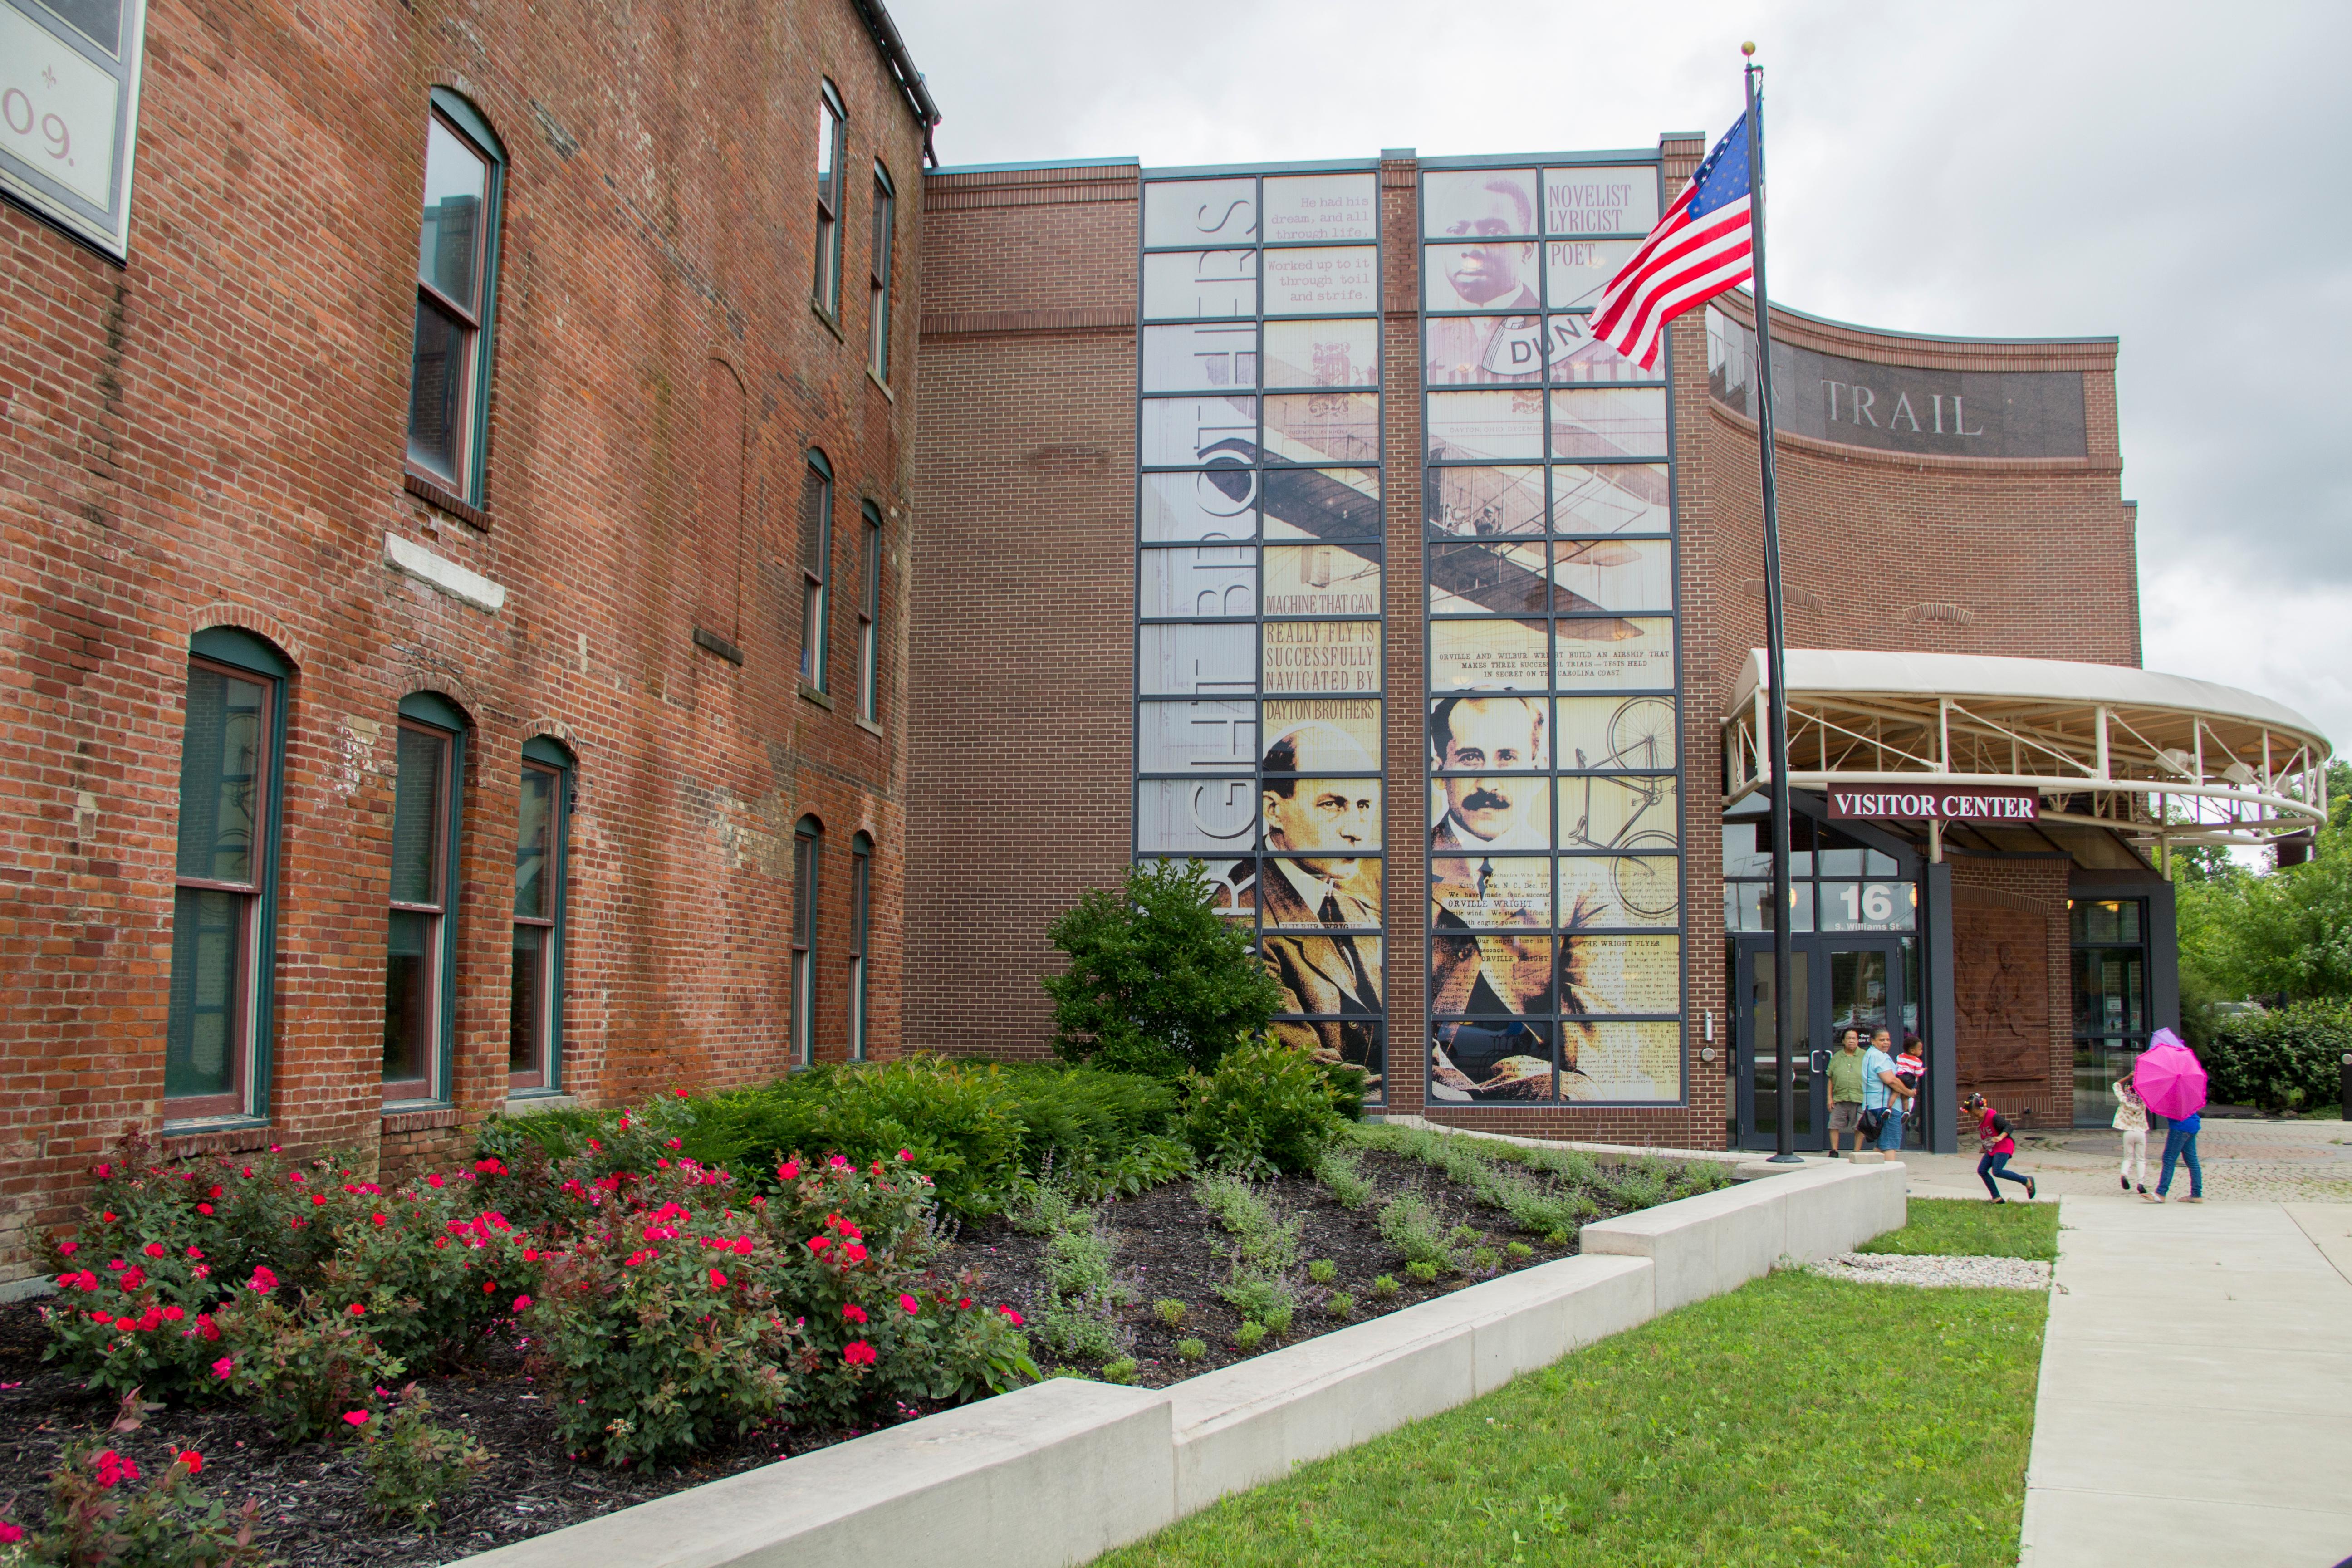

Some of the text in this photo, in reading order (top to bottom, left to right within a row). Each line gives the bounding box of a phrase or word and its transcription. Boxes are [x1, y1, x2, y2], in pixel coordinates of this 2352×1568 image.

[1301, 196, 1368, 207] He had his
[1549, 185, 1631, 207] NOVELIST
[1271, 212, 1368, 225] dream, and all
[1549, 209, 1622, 232] LYRICIST
[1276, 228, 1368, 240] through life,
[1267, 259, 1369, 271] Worked up to it
[1551, 244, 1595, 266] POET
[1280, 274, 1370, 287] through toil
[1291, 291, 1368, 301] and strife.
[1510, 317, 1596, 364] DUN
[1190, 198, 1258, 625] BROTHERS
[1822, 379, 1984, 436] TRAIL
[1266, 594, 1373, 614] MACHINE THAT CAN
[1267, 622, 1374, 642] REALLY FLY IS
[1267, 647, 1374, 666] SUCCESSFULLY
[1266, 671, 1374, 690] NAVIGATED BY
[1267, 700, 1374, 720] DAYTON BROTHERS
[1835, 794, 2034, 818] VISITOR CENTER
[1840, 885, 1892, 920] 16
